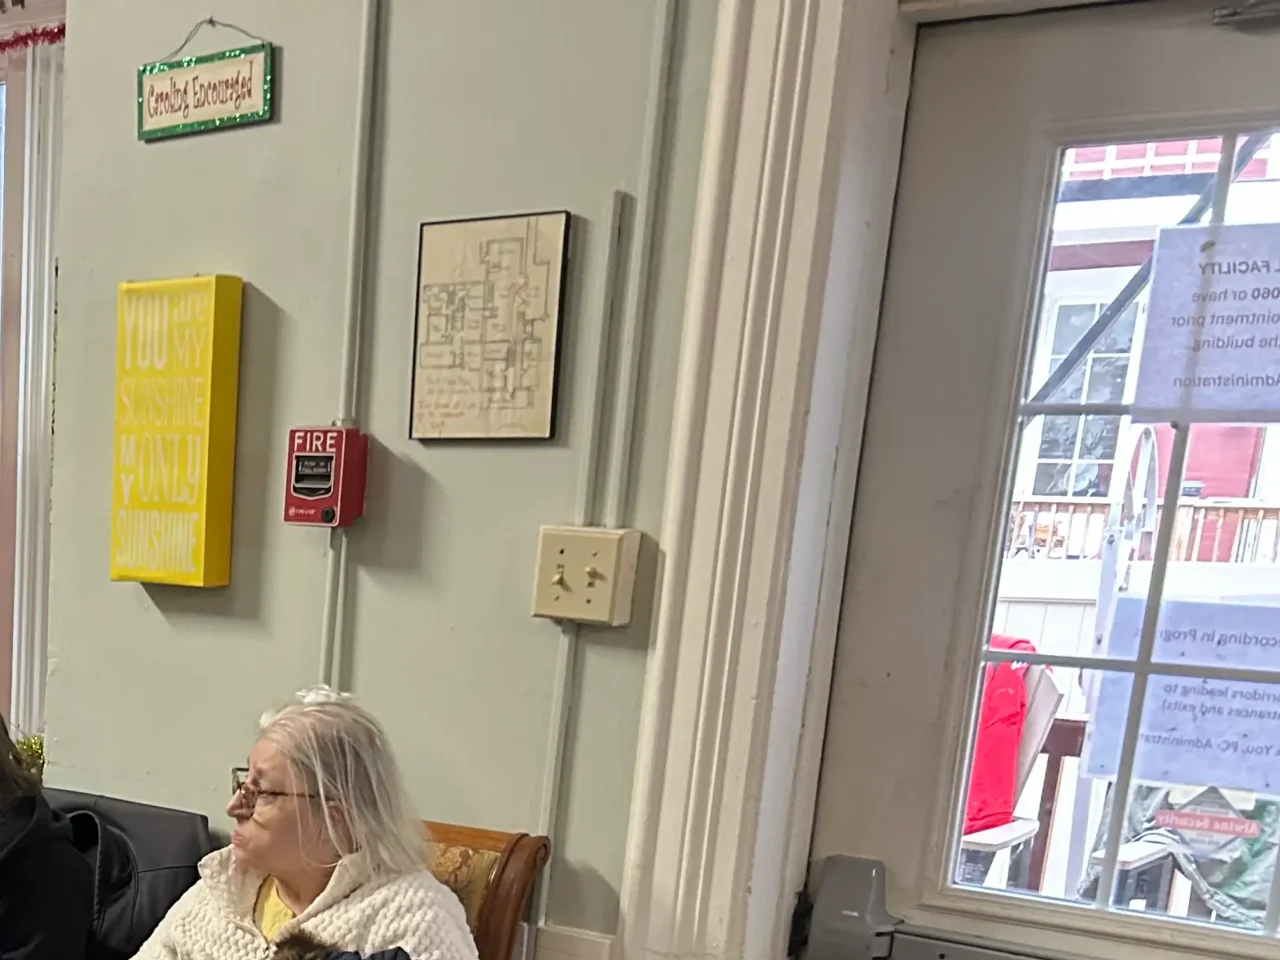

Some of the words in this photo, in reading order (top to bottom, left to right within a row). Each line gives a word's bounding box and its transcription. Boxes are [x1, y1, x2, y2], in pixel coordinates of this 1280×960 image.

[147, 76, 189, 119] Caroling
[192, 60, 253, 110] Encouraged
[123, 293, 169, 370] YOU
[173, 326, 208, 369] MY
[120, 377, 203, 427] SUNSHINE
[138, 432, 201, 506] ONLY
[294, 432, 337, 452] FIRE
[115, 508, 199, 574] SUNSHINE
